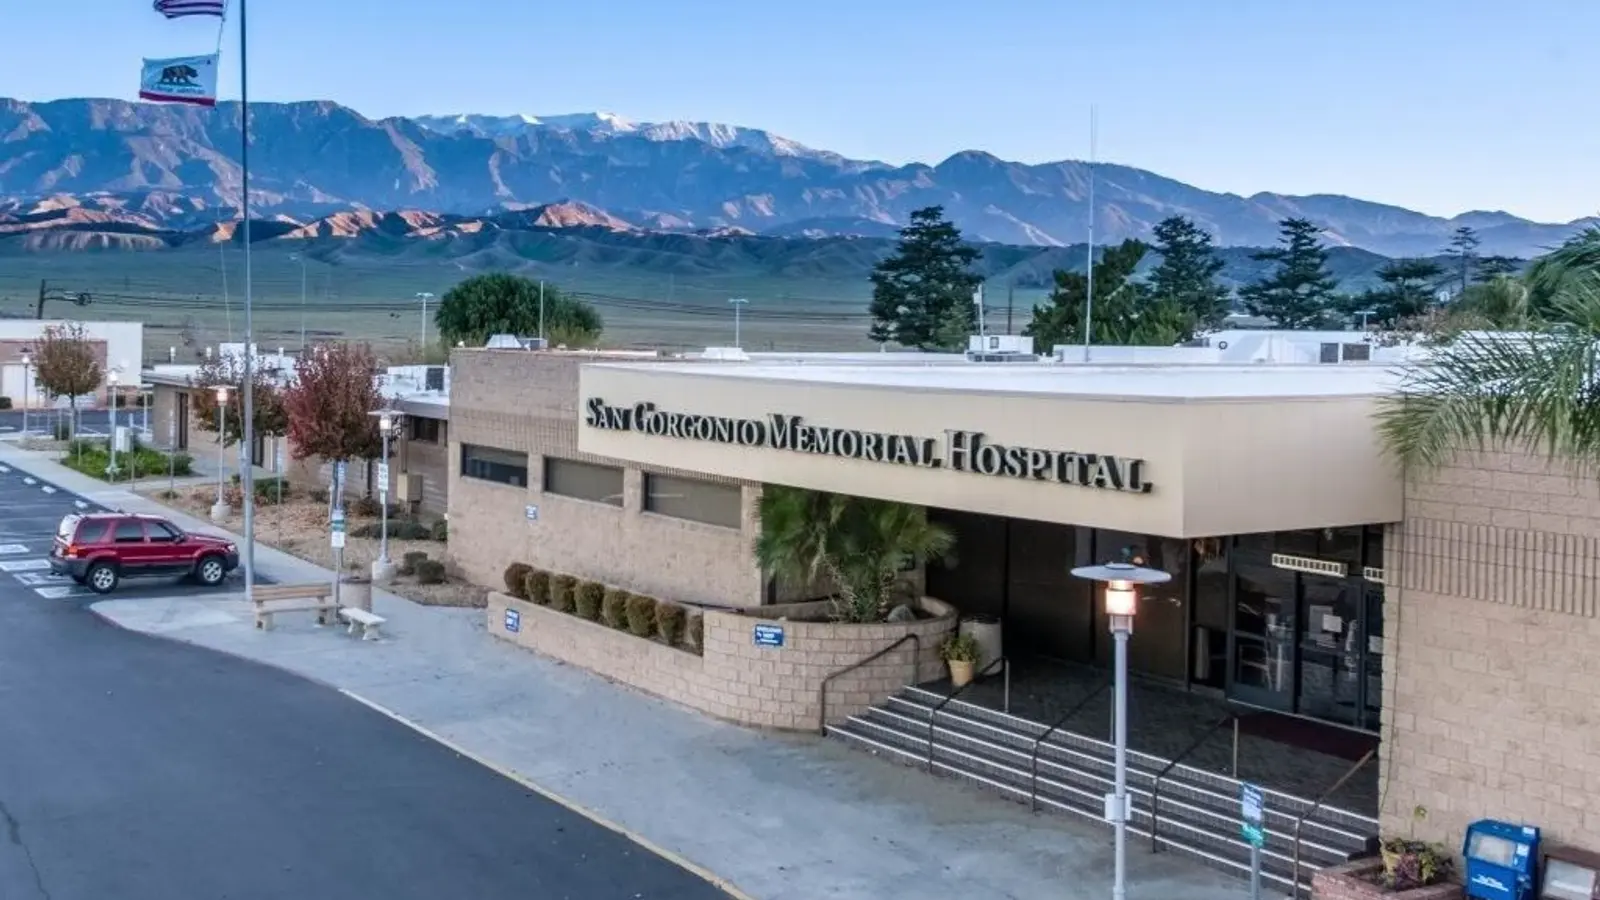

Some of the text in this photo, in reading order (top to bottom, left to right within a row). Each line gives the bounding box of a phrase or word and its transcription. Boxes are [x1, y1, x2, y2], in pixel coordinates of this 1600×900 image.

[586, 397, 1153, 493] SAN GORGONIO MEMORIAL HOSPITAL
